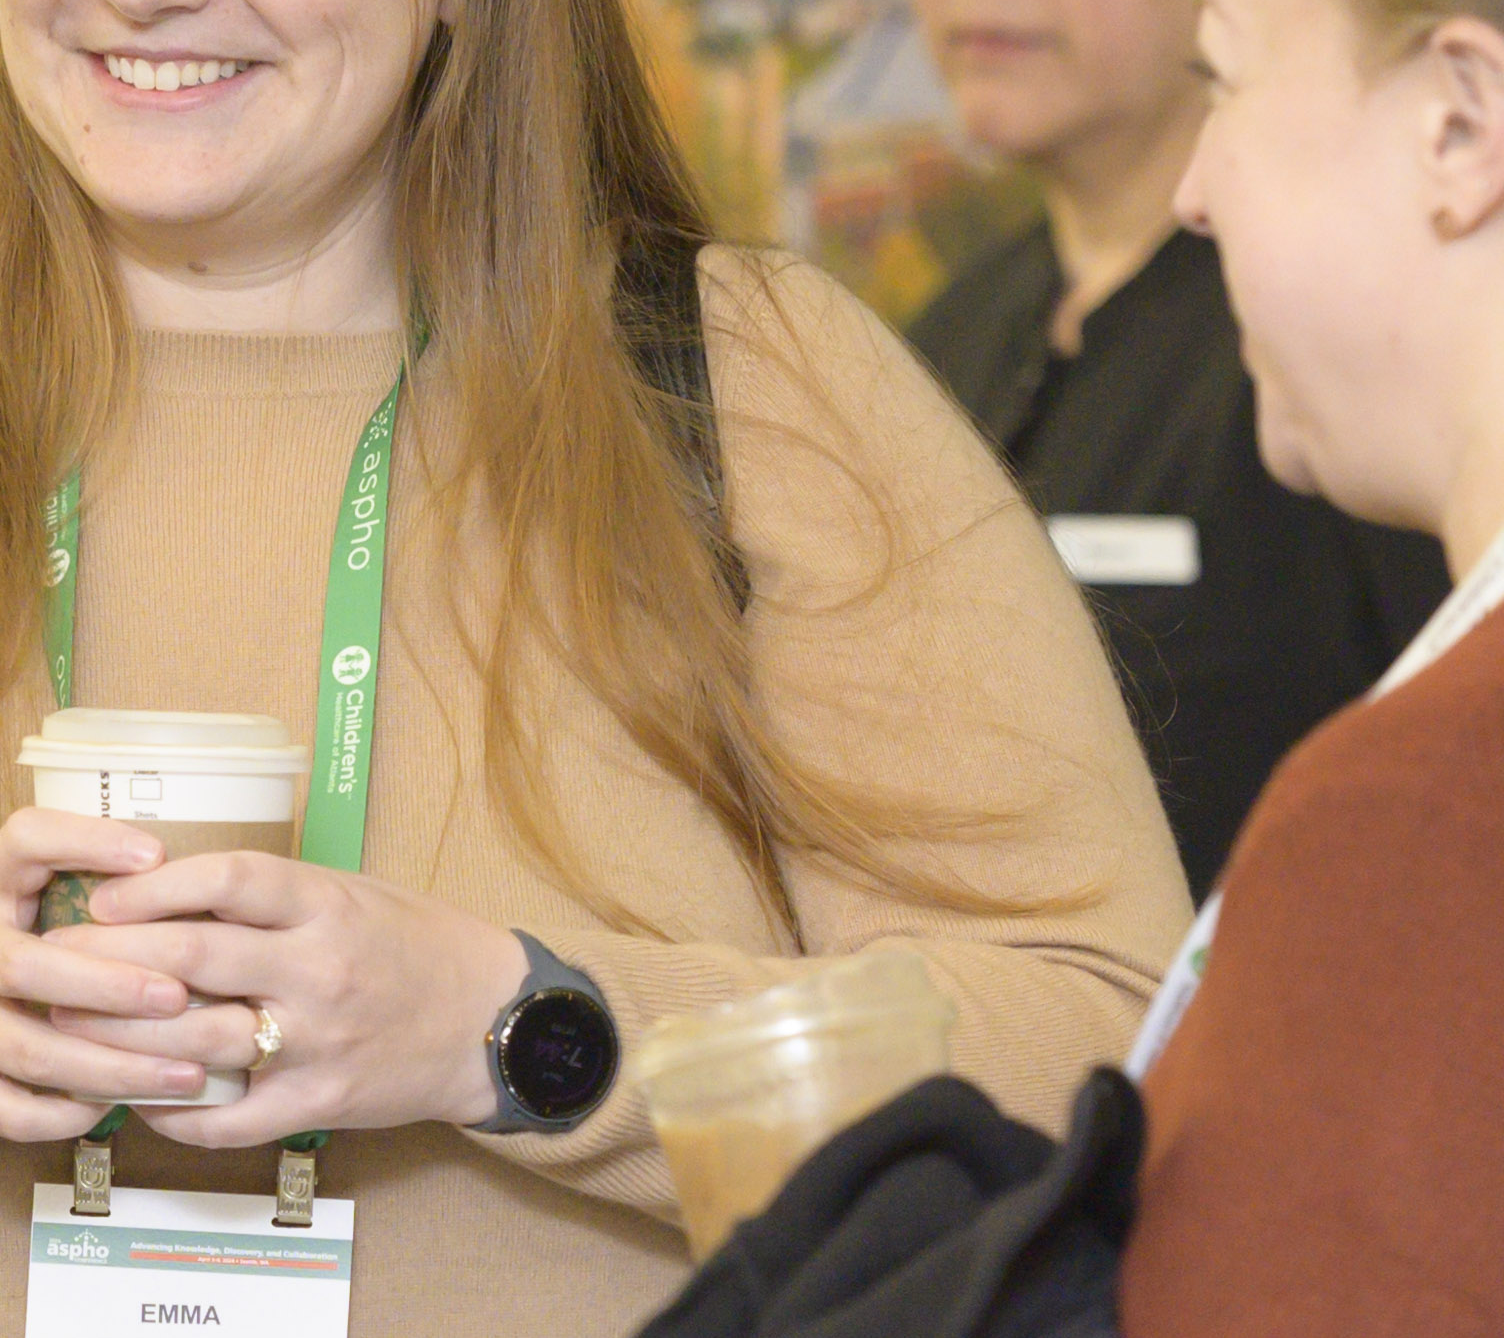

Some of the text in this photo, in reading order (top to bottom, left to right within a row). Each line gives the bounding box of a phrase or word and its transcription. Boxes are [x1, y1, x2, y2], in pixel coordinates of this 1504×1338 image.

[348, 451, 380, 571] aspho
[338, 689, 364, 793] Children's
[47, 1240, 109, 1261] aspho
[141, 1303, 221, 1325] EMMA
